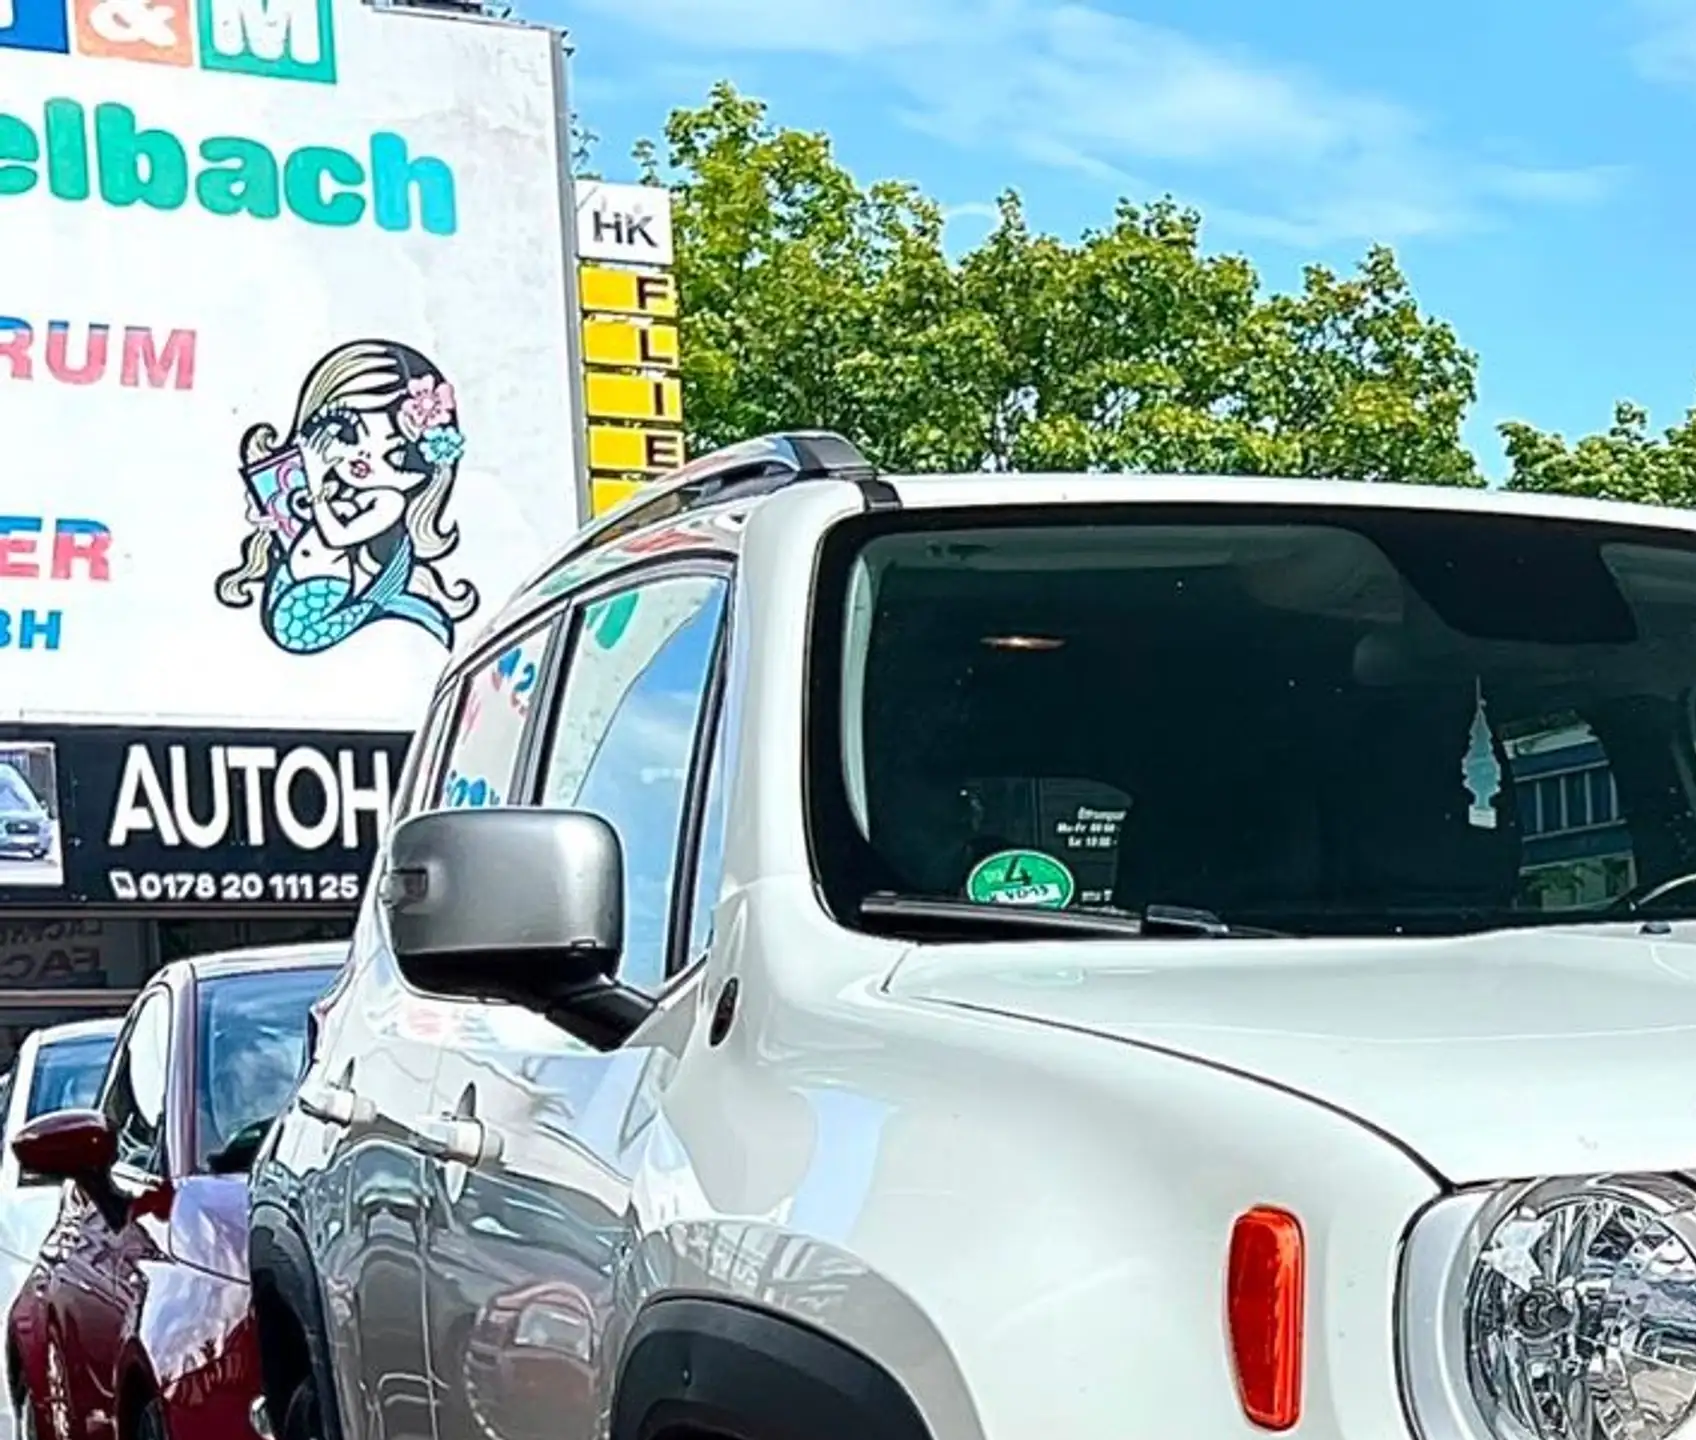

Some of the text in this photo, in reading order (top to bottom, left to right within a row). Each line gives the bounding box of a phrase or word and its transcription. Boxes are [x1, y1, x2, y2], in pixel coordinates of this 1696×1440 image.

[108, 744, 390, 849] AUTOH
[139, 872, 360, 900] 0178 20 111 25
